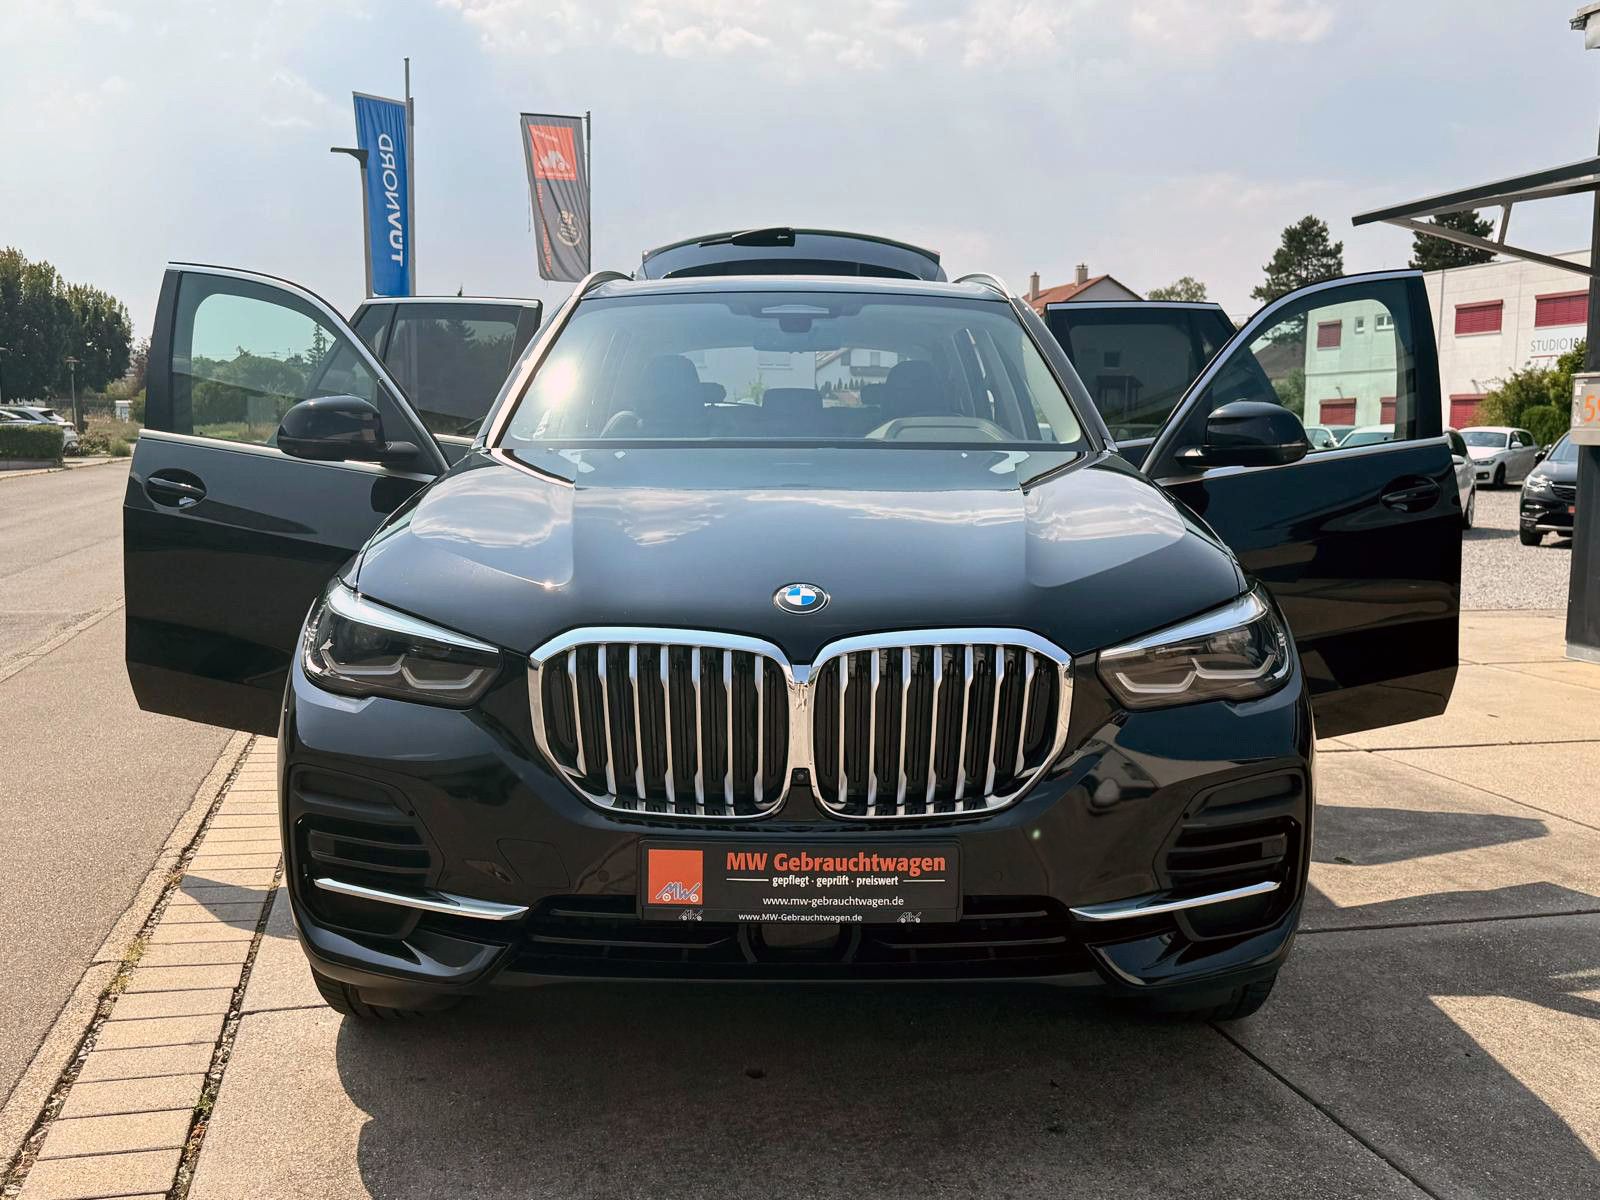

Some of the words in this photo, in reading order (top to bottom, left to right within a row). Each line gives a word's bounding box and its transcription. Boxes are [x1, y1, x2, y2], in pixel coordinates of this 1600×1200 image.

[1584, 394, 1600, 423] 5
[726, 852, 768, 871] MW
[773, 851, 946, 877] Gebrauchtwagen
[772, 875, 810, 887] gepflegt
[816, 875, 850, 887] geprüft
[856, 875, 899, 887] preiswert
[762, 895, 905, 908] www.mw-gebrauchtwagen.de
[738, 912, 863, 922] www.MW-Gebrauchtwagen.de
